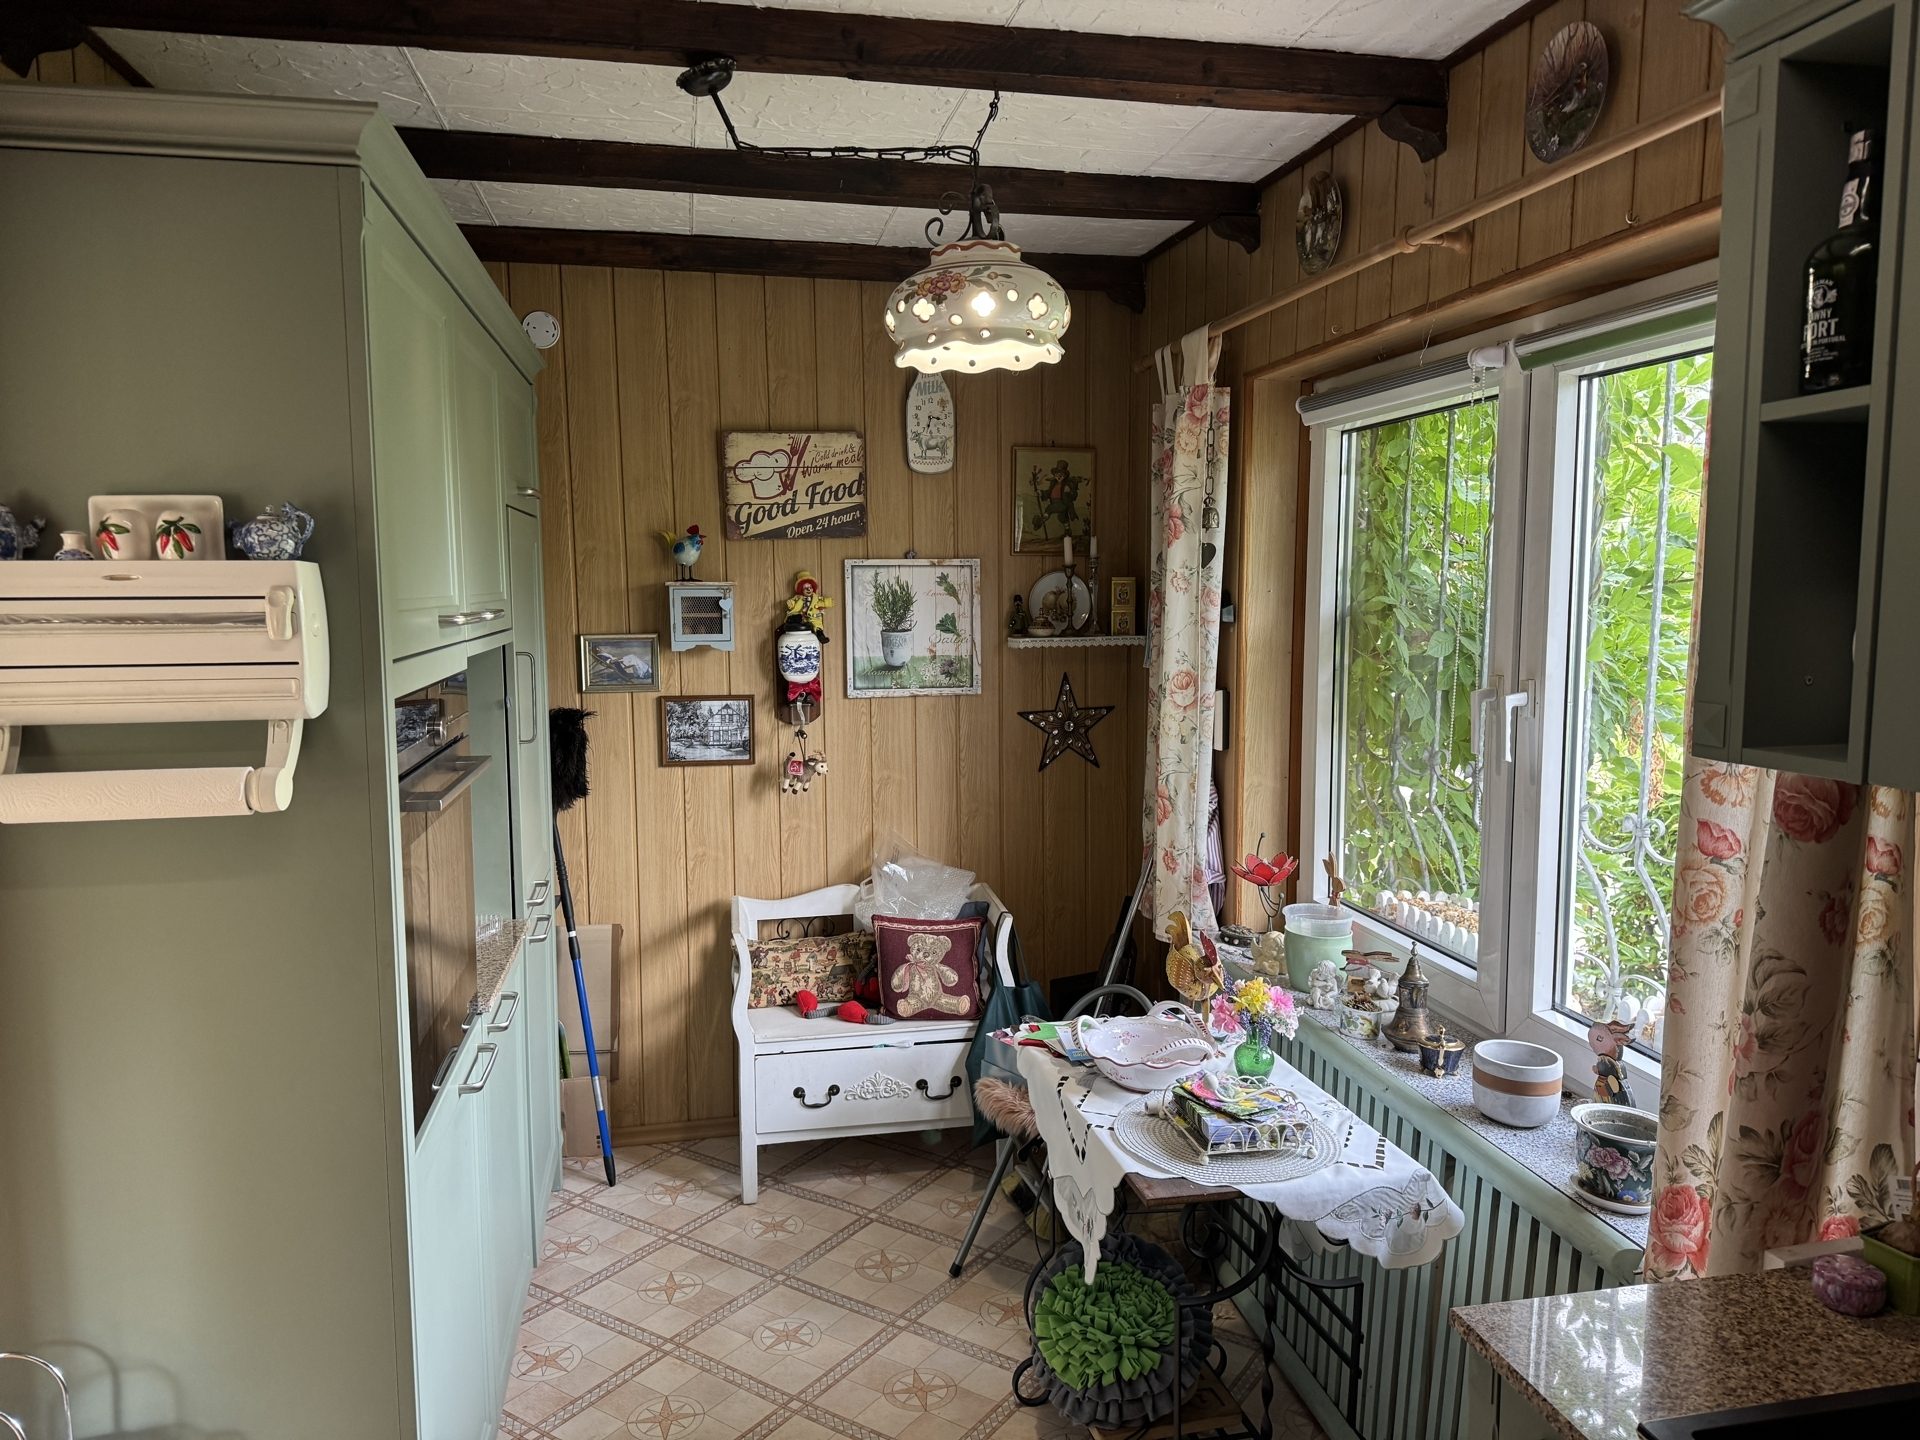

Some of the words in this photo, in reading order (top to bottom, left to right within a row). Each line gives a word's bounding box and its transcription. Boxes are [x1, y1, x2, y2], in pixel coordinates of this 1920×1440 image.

[1803, 318, 1839, 341] PORT
[921, 398, 926, 406] 11
[802, 457, 833, 478] Warm
[815, 450, 830, 463] Cold
[734, 489, 800, 535] Good
[805, 472, 865, 510] Food
[786, 521, 814, 539] Open
[816, 516, 829, 531] 24
[830, 510, 860, 526] hours
